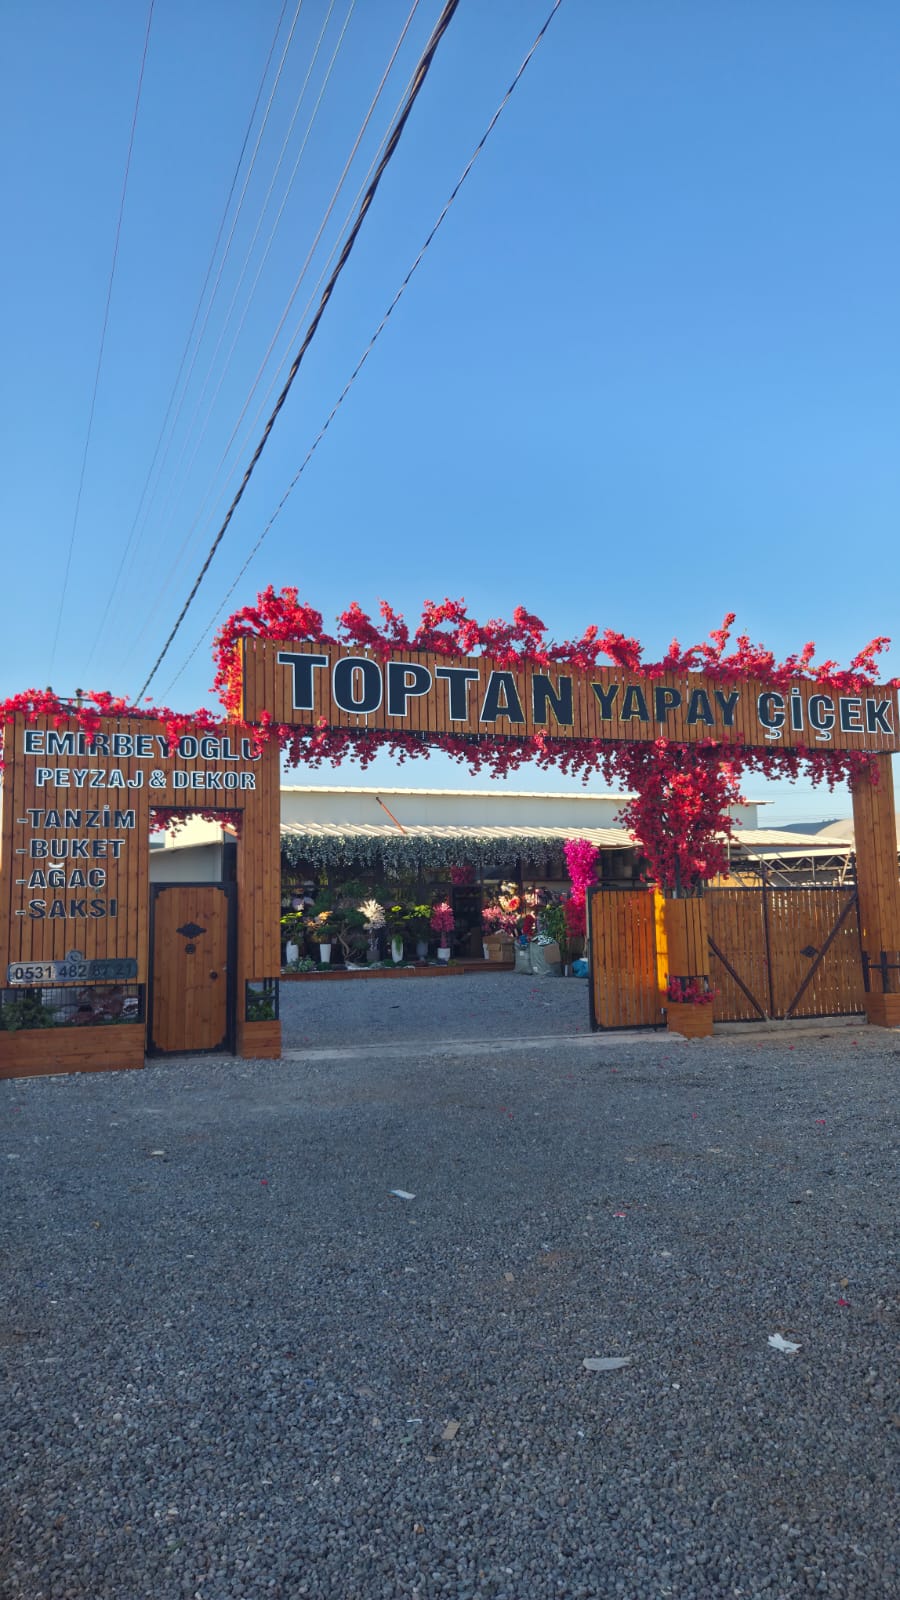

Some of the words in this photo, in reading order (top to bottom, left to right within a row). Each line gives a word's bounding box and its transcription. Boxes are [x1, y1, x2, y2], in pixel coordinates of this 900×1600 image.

[277, 651, 574, 726] TOPTAN
[590, 681, 740, 726] YAPAY
[757, 687, 895, 742] ÇİÇEK
[35, 767, 144, 788] PEYZAJ
[149, 770, 167, 788] &
[173, 770, 257, 790] DEKOR
[15, 966, 53, 980] 0531
[58, 965, 88, 978] 482
